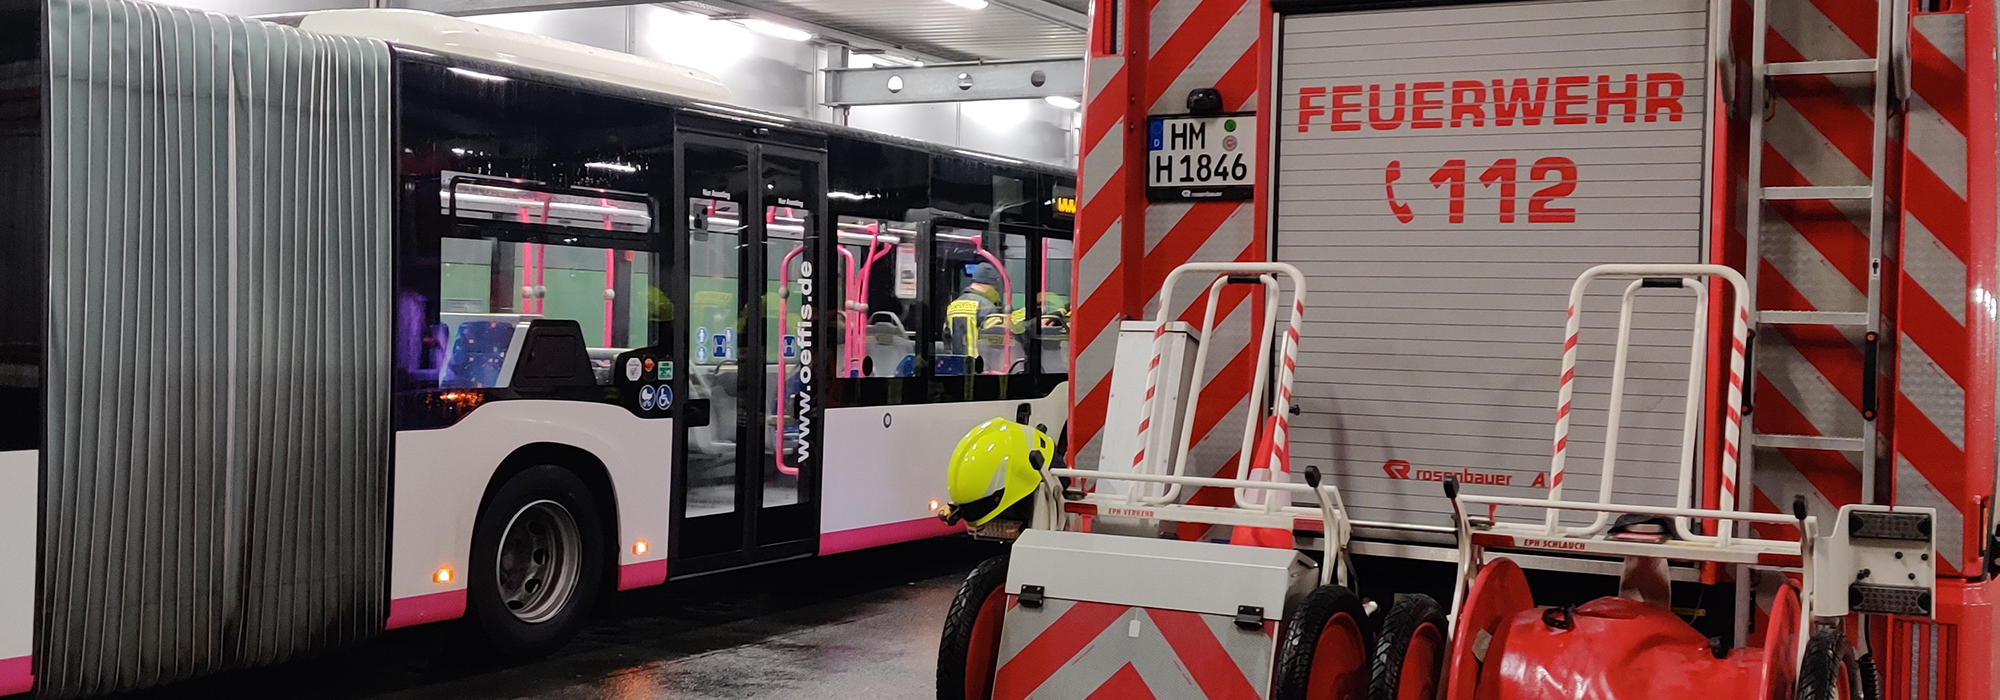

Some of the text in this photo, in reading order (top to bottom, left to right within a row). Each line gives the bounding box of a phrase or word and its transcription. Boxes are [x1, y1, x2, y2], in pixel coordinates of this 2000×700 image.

[1297, 72, 1684, 133] FEUERWEHR
[1153, 138, 1161, 148] D
[1170, 121, 1206, 151] HM
[1156, 152, 1248, 183] H 1846
[1428, 156, 1578, 224] 112
[797, 260, 813, 463] www.oeffis.de
[1523, 538, 1586, 550] EPH SCHLAUCH
